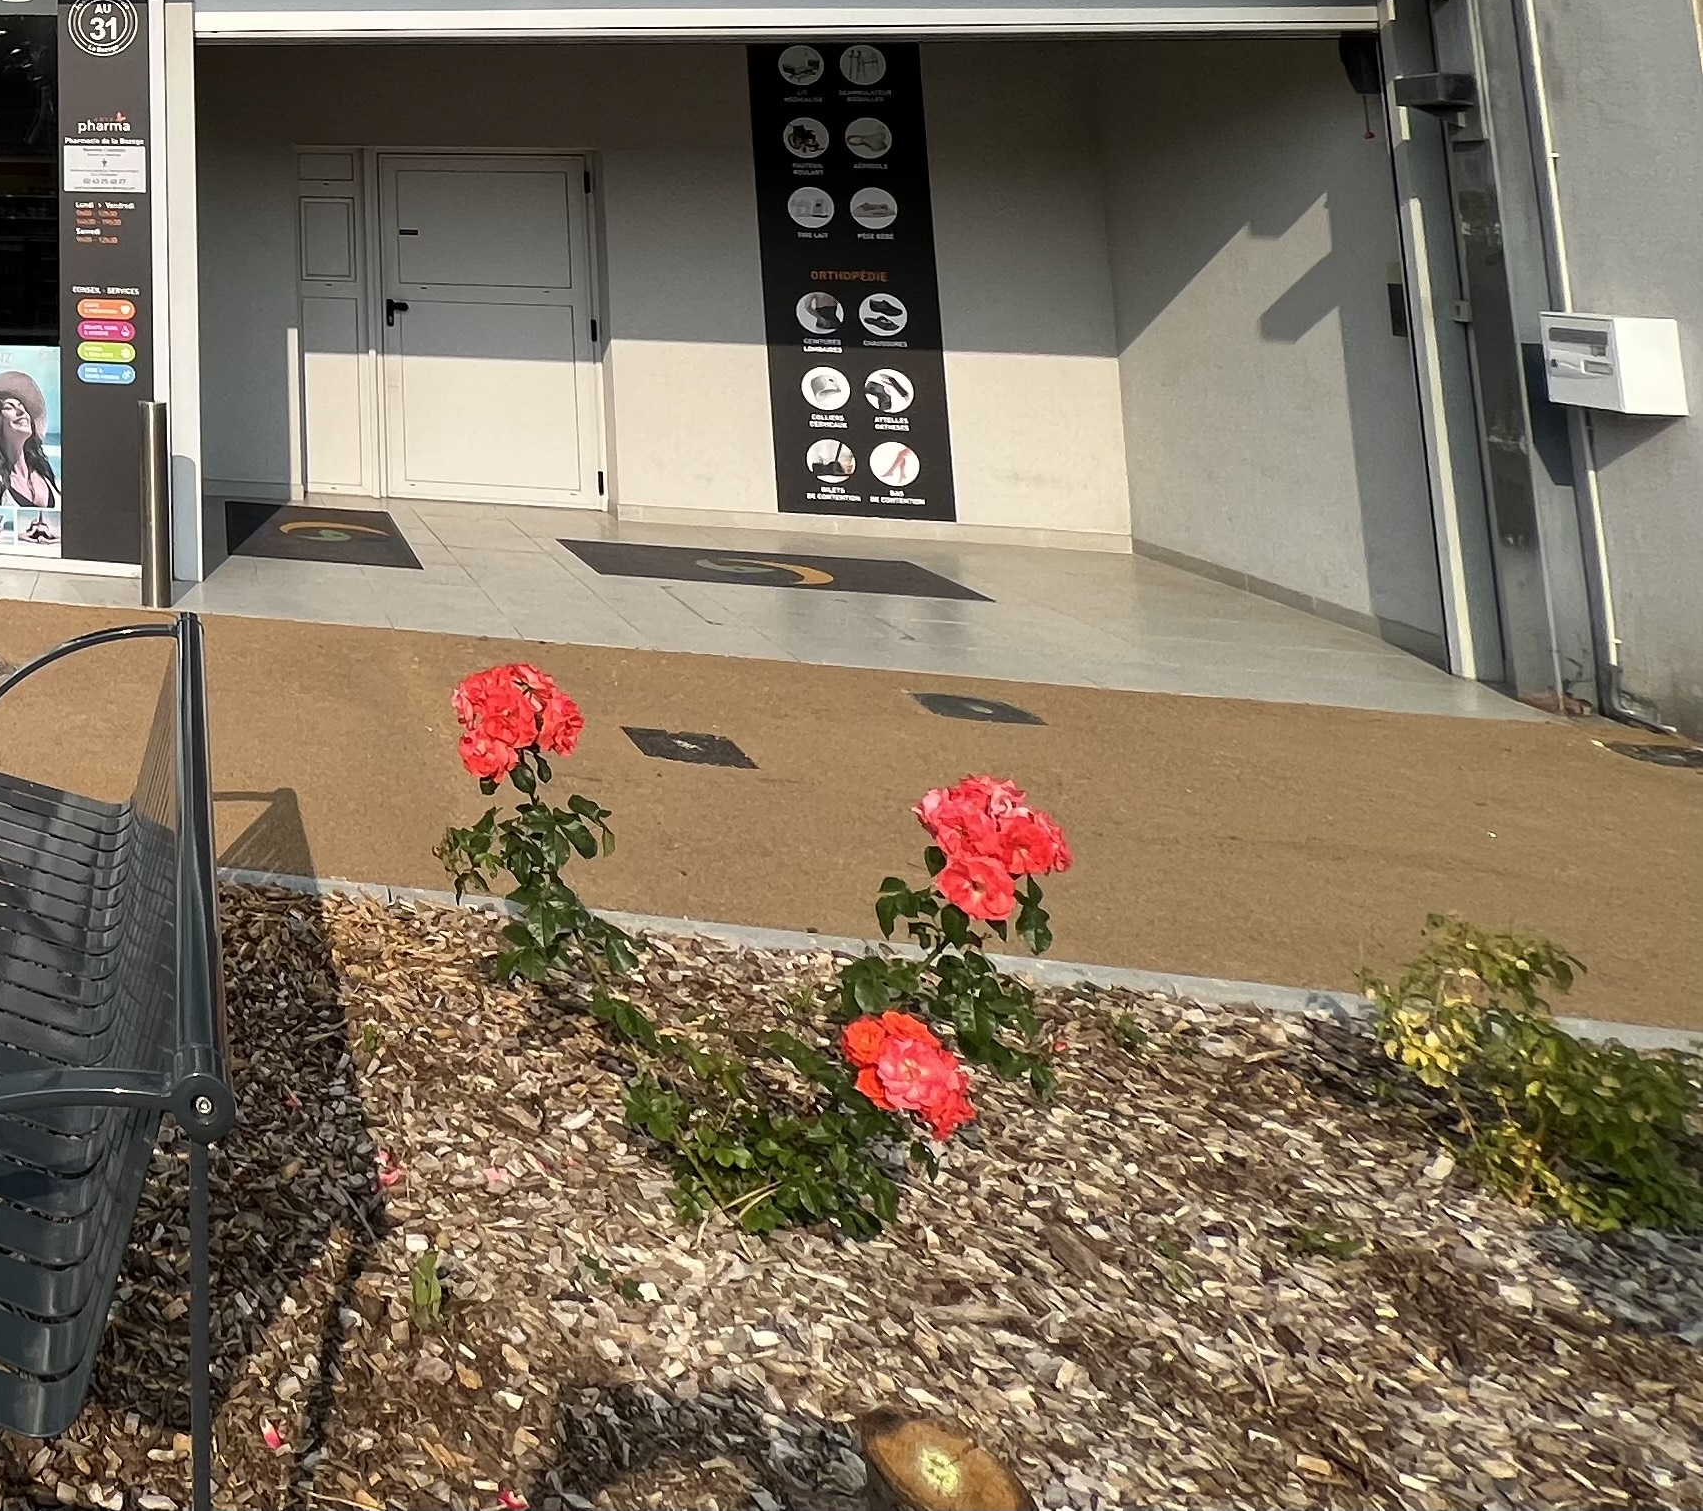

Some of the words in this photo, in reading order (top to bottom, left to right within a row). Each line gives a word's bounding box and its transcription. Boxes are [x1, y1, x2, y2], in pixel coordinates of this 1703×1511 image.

[94, 4, 112, 14] AU
[89, 17, 117, 40] 31
[78, 119, 131, 134] pharma
[810, 269, 889, 282] ORTHOPÉDIE
